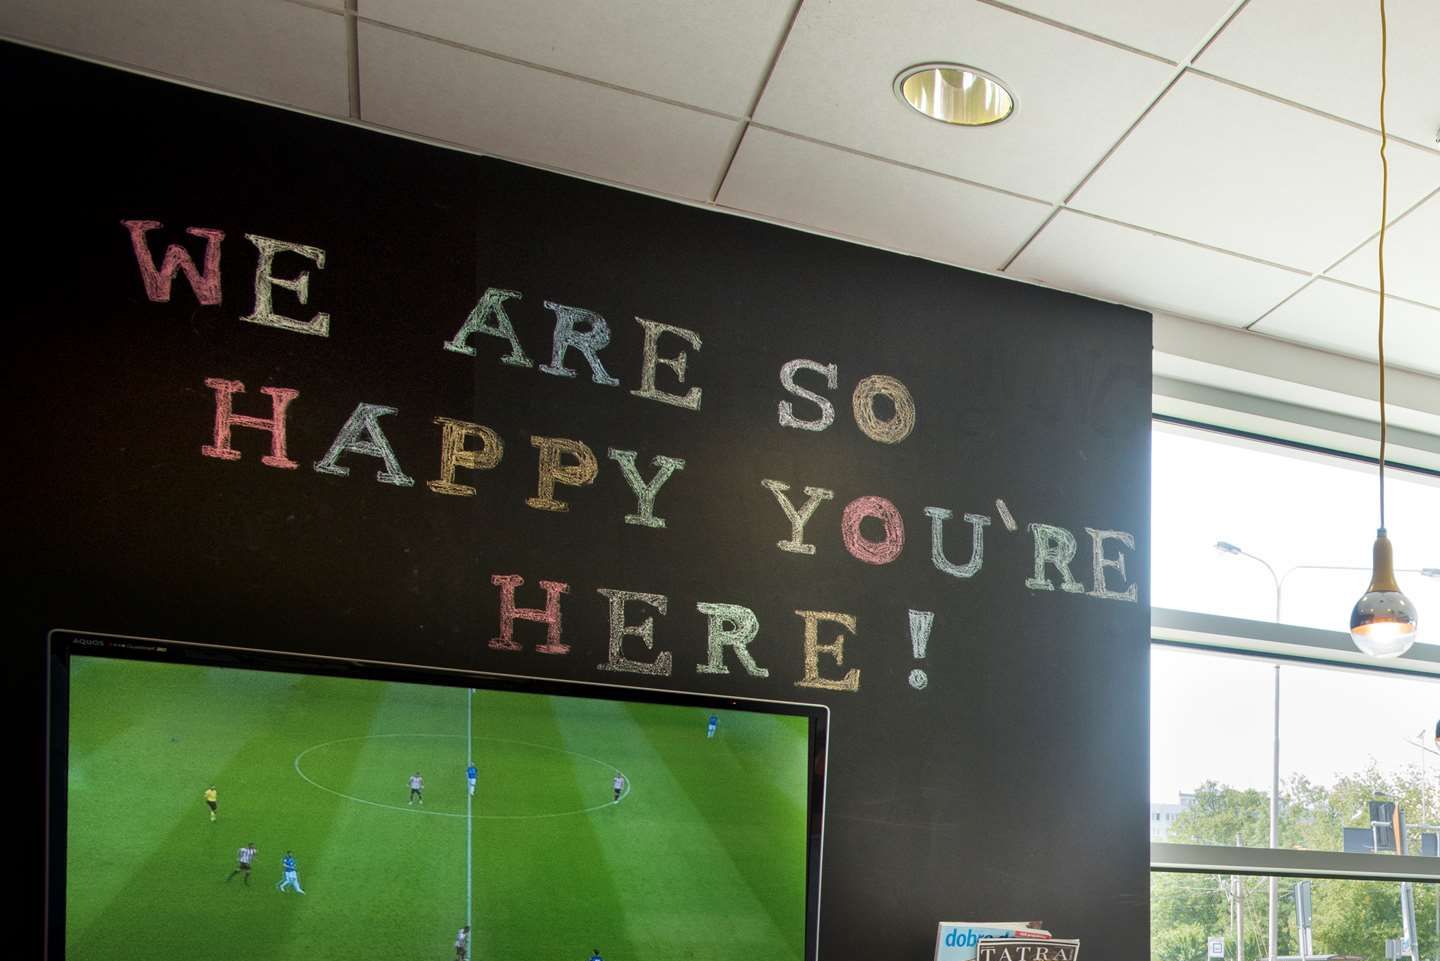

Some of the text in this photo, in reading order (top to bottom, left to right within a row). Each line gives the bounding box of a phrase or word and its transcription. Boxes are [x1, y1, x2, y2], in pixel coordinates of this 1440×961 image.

[120, 219, 916, 444] WE ARE SO
[201, 377, 686, 528] HAPPY
